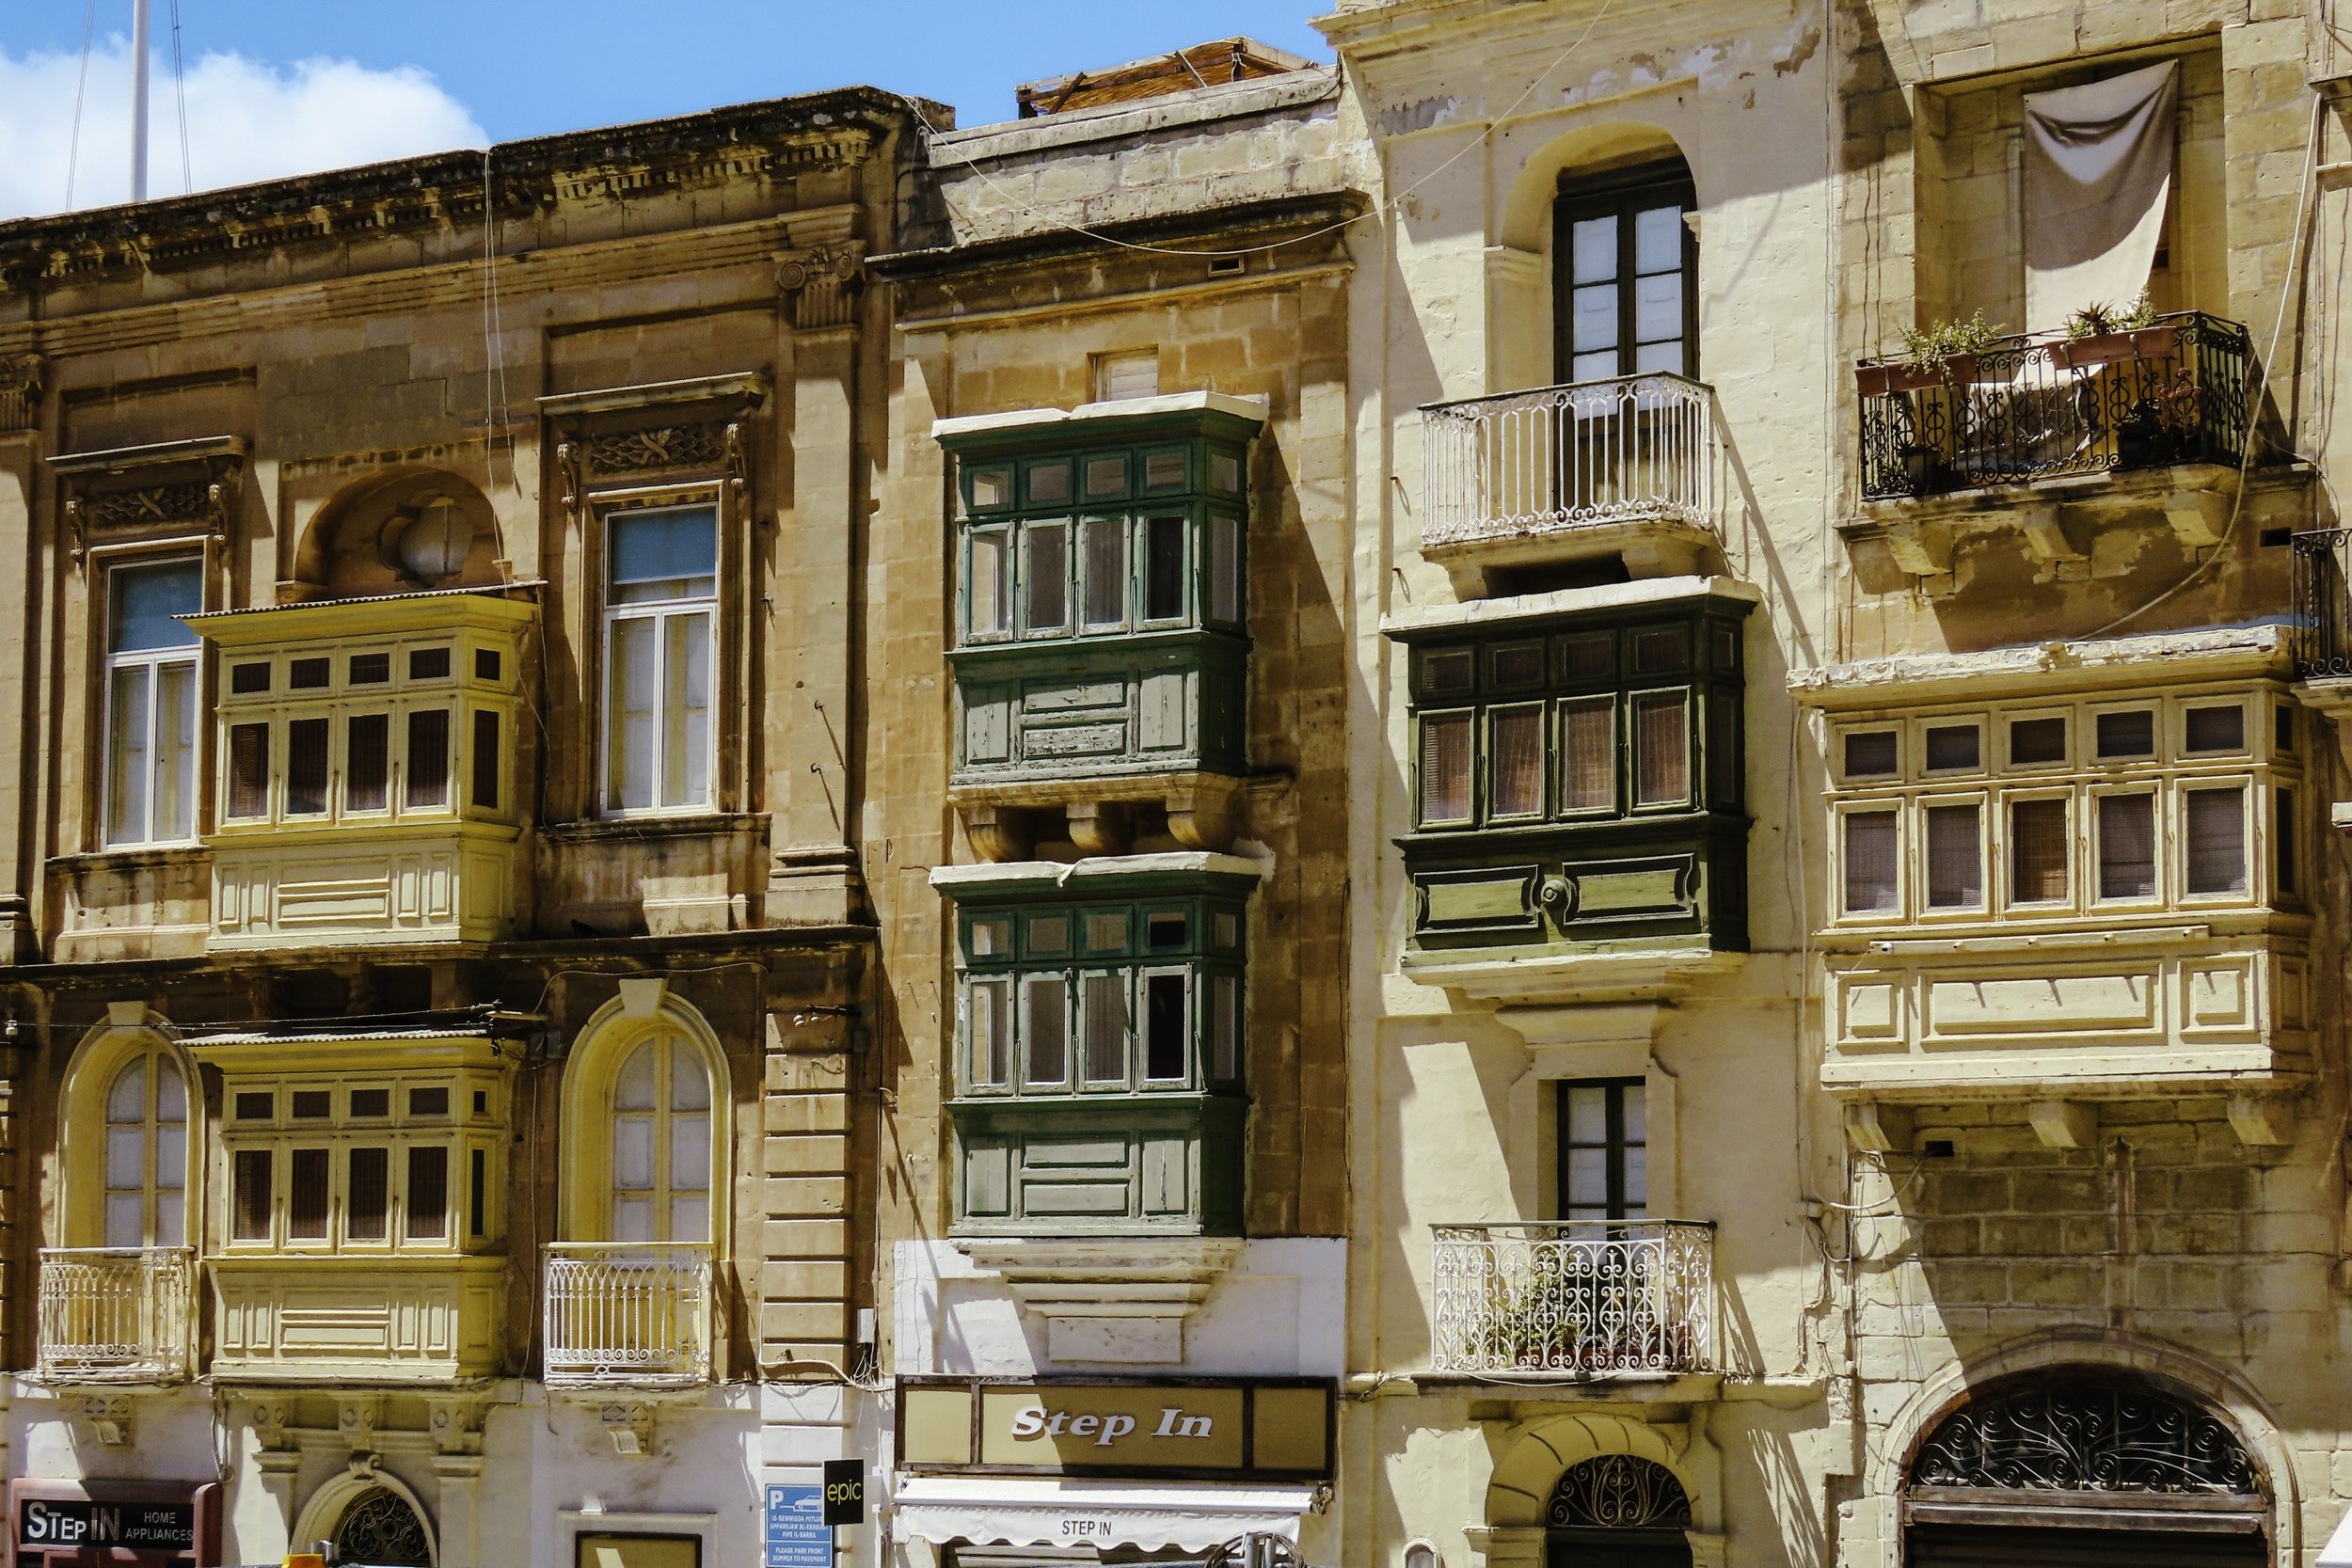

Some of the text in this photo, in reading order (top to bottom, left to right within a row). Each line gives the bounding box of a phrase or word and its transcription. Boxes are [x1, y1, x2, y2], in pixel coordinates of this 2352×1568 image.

[1010, 1407, 1213, 1446] Step In
[770, 1490, 784, 1510] P
[827, 1479, 862, 1506] epic
[91, 1507, 119, 1541] IN
[144, 1512, 176, 1524] HOME
[125, 1528, 194, 1541] APPLIANCES
[1062, 1520, 1112, 1536] STEP IN
[801, 1555, 827, 1563] PAVEMENT
